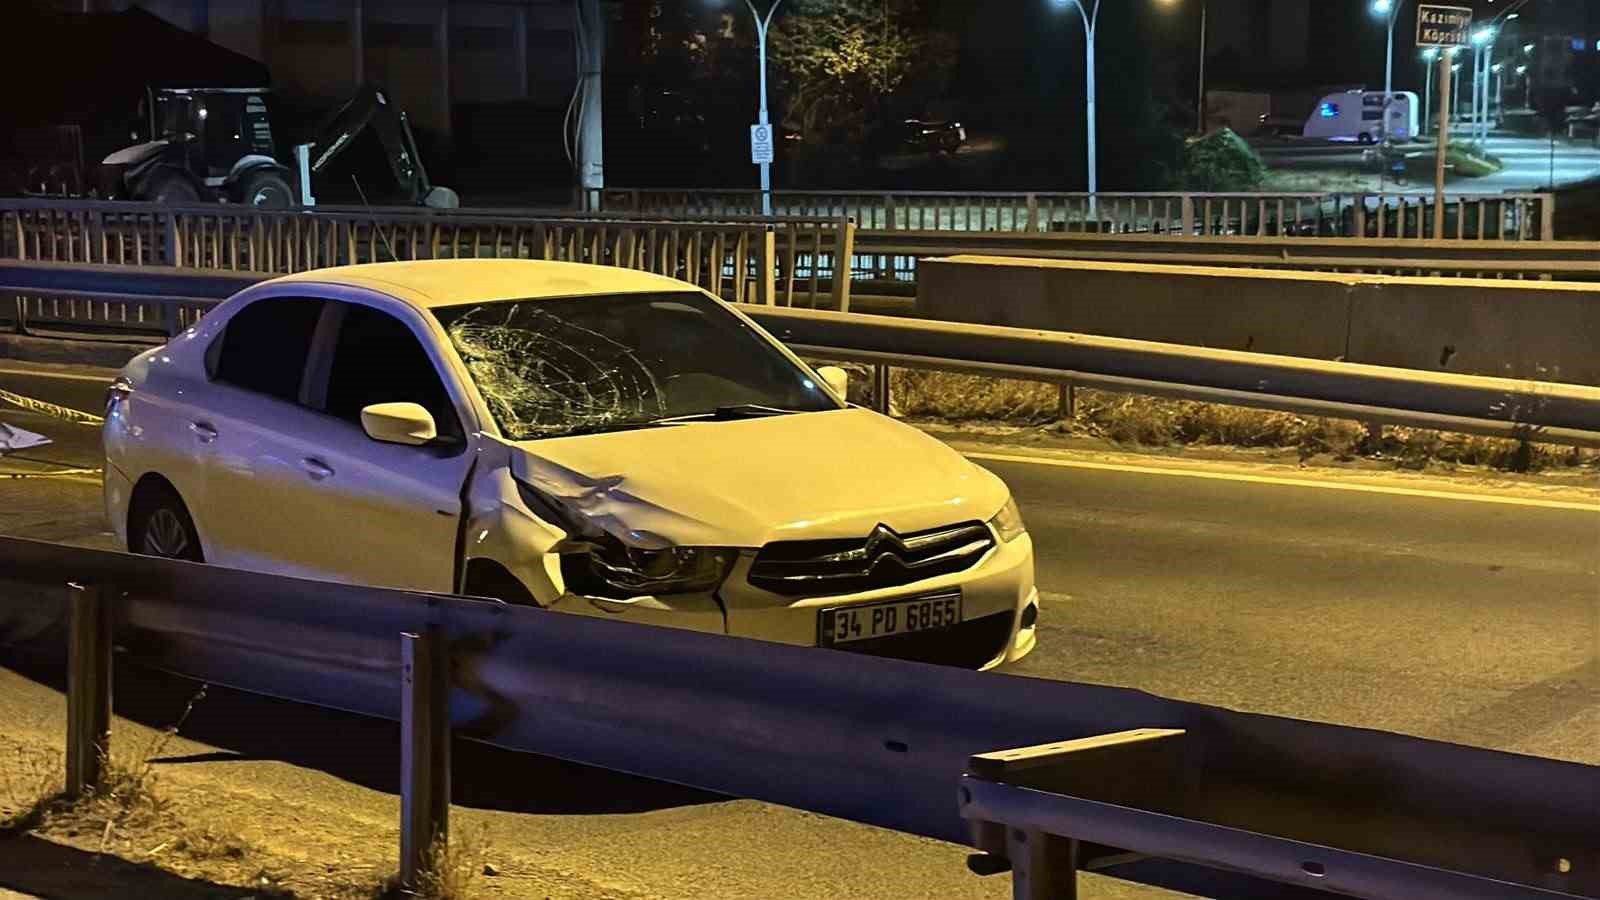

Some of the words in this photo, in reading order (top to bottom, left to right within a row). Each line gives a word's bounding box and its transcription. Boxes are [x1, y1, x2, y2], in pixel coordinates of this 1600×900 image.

[836, 611, 861, 640] 34
[871, 607, 896, 635] PD
[906, 599, 955, 632] 6855
